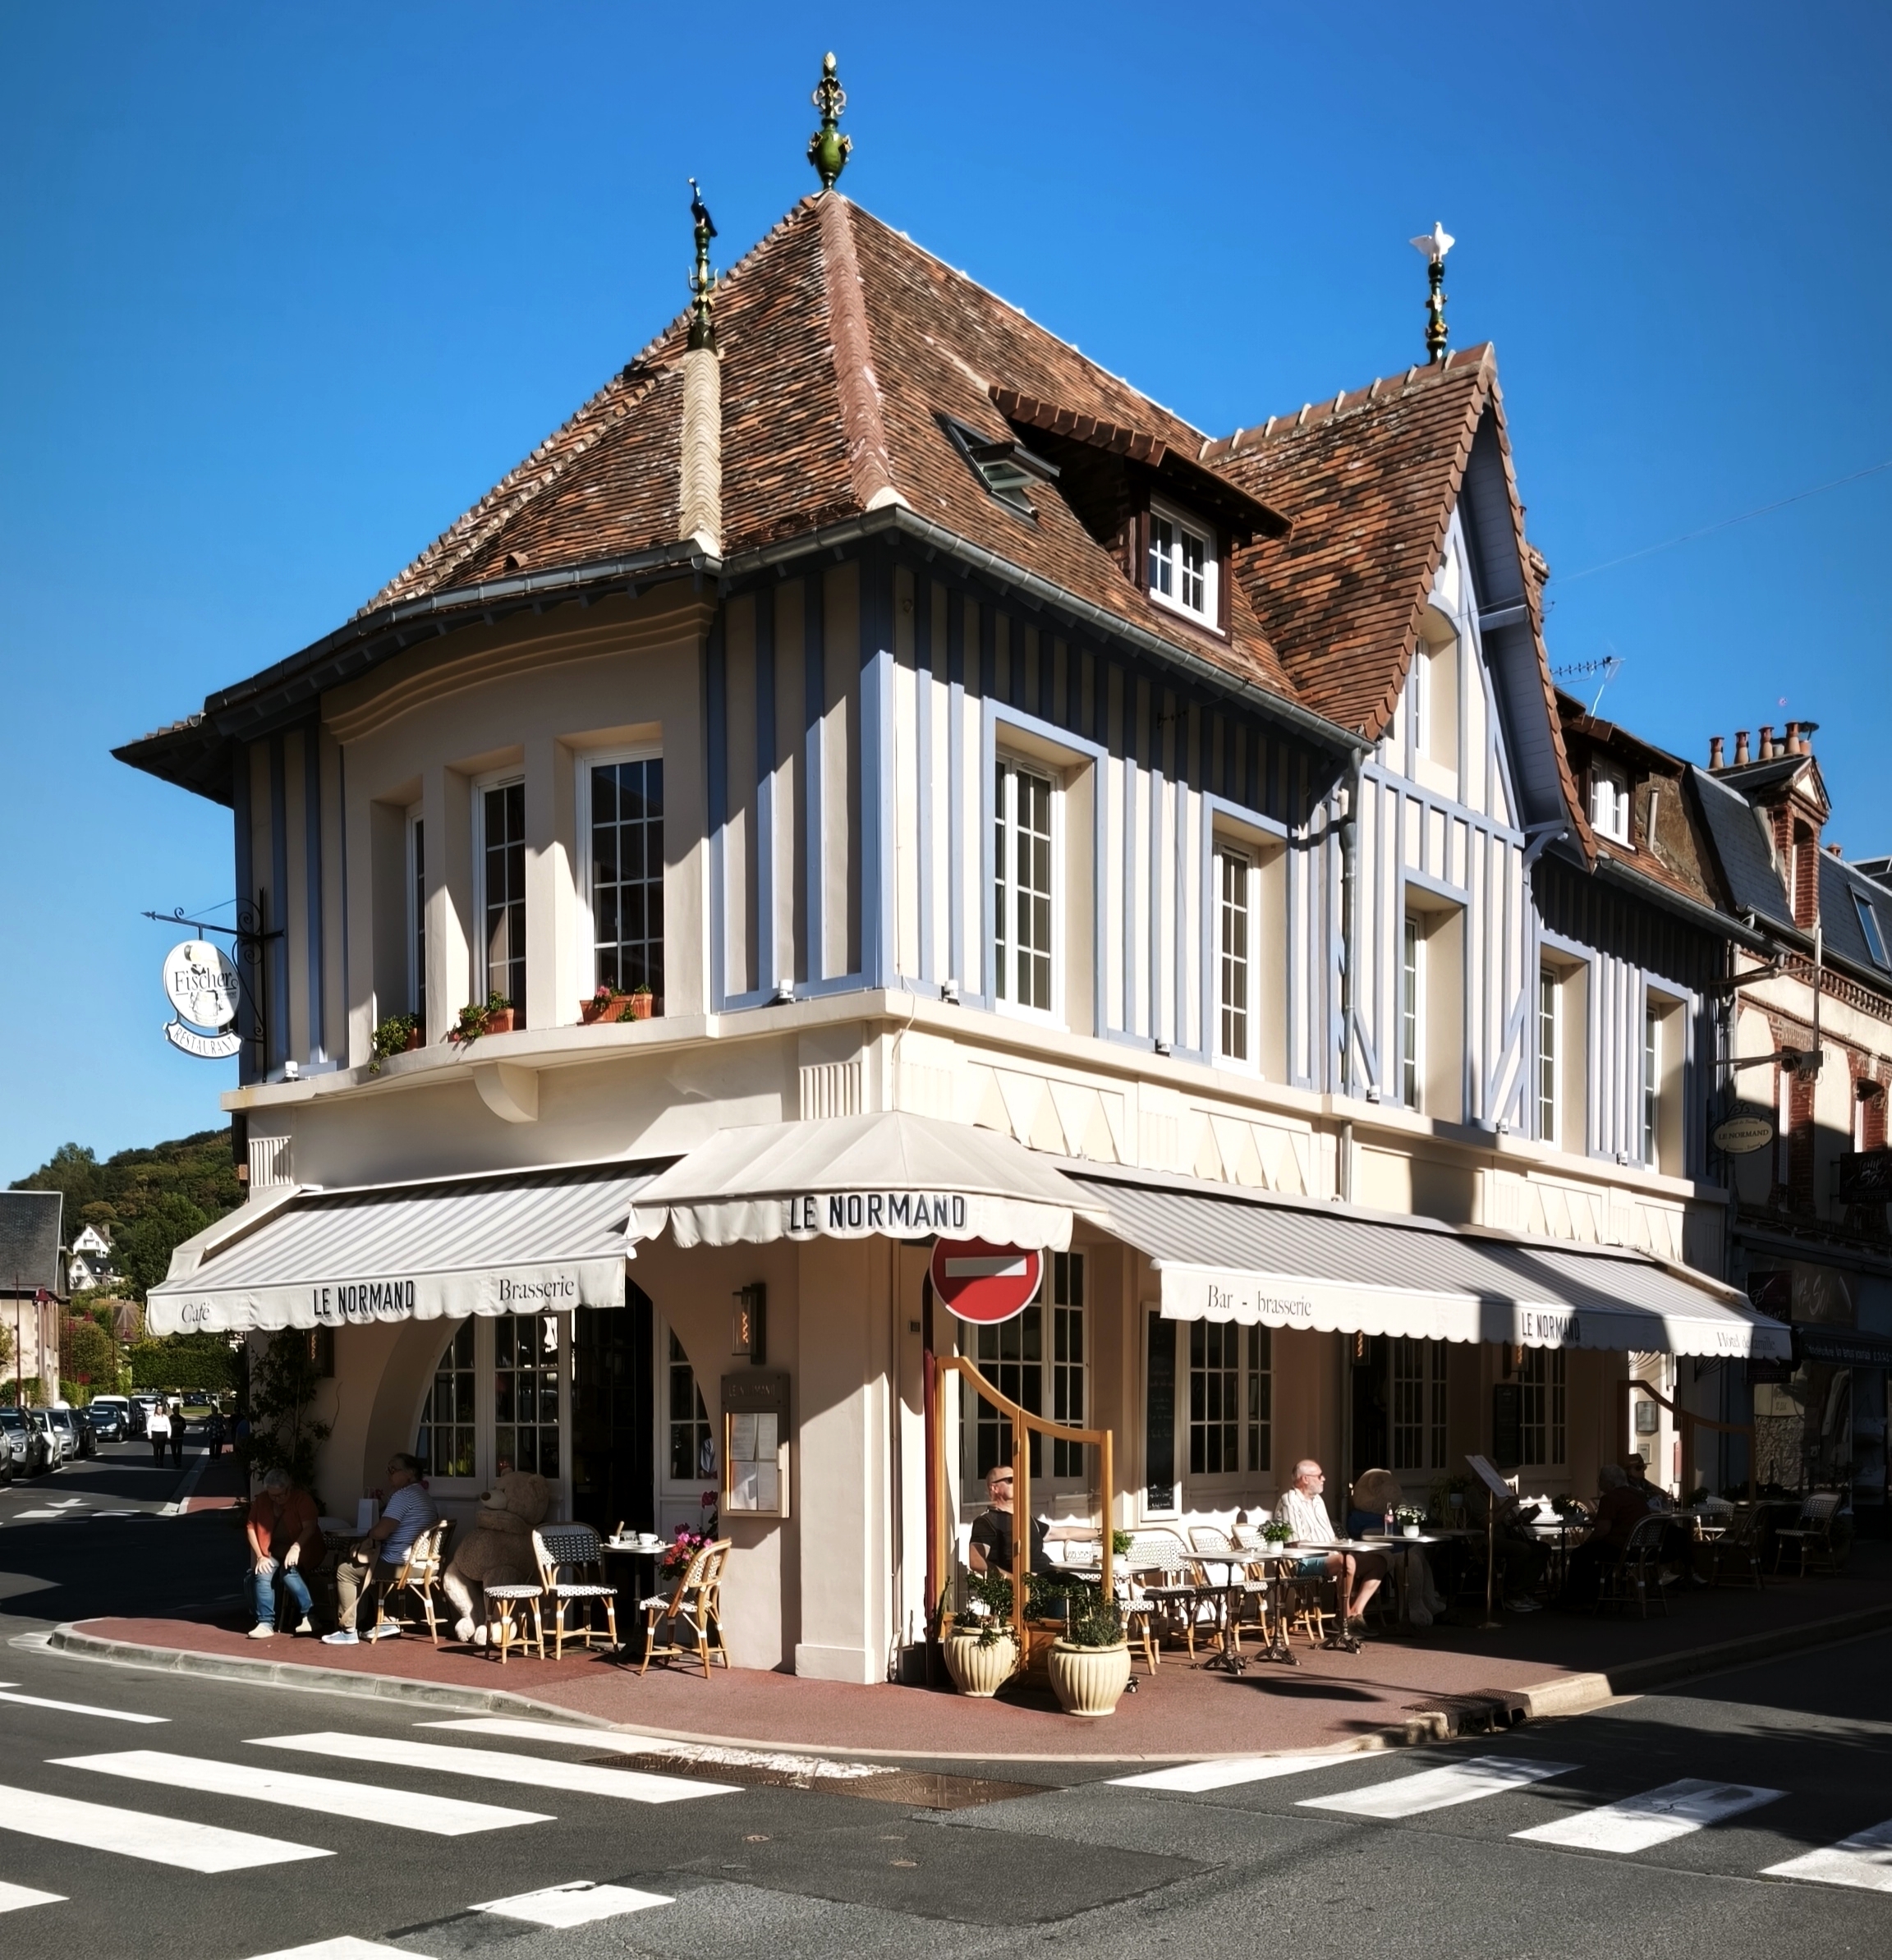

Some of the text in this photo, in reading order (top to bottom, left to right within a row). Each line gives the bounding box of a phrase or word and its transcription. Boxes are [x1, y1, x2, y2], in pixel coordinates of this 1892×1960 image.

[174, 967, 238, 992] Fischer
[173, 1026, 236, 1056] RESTAURANT
[1719, 1129, 1769, 1141] LE NORMAND
[790, 1192, 966, 1231] LE NORMAND
[314, 1280, 415, 1316] LE NORMAND
[499, 1275, 575, 1301] Brasserie
[1208, 1285, 1233, 1309] Bar
[1258, 1290, 1311, 1316] brasserie
[181, 1301, 210, 1324] Café
[1522, 1312, 1581, 1342] LE NORMAND
